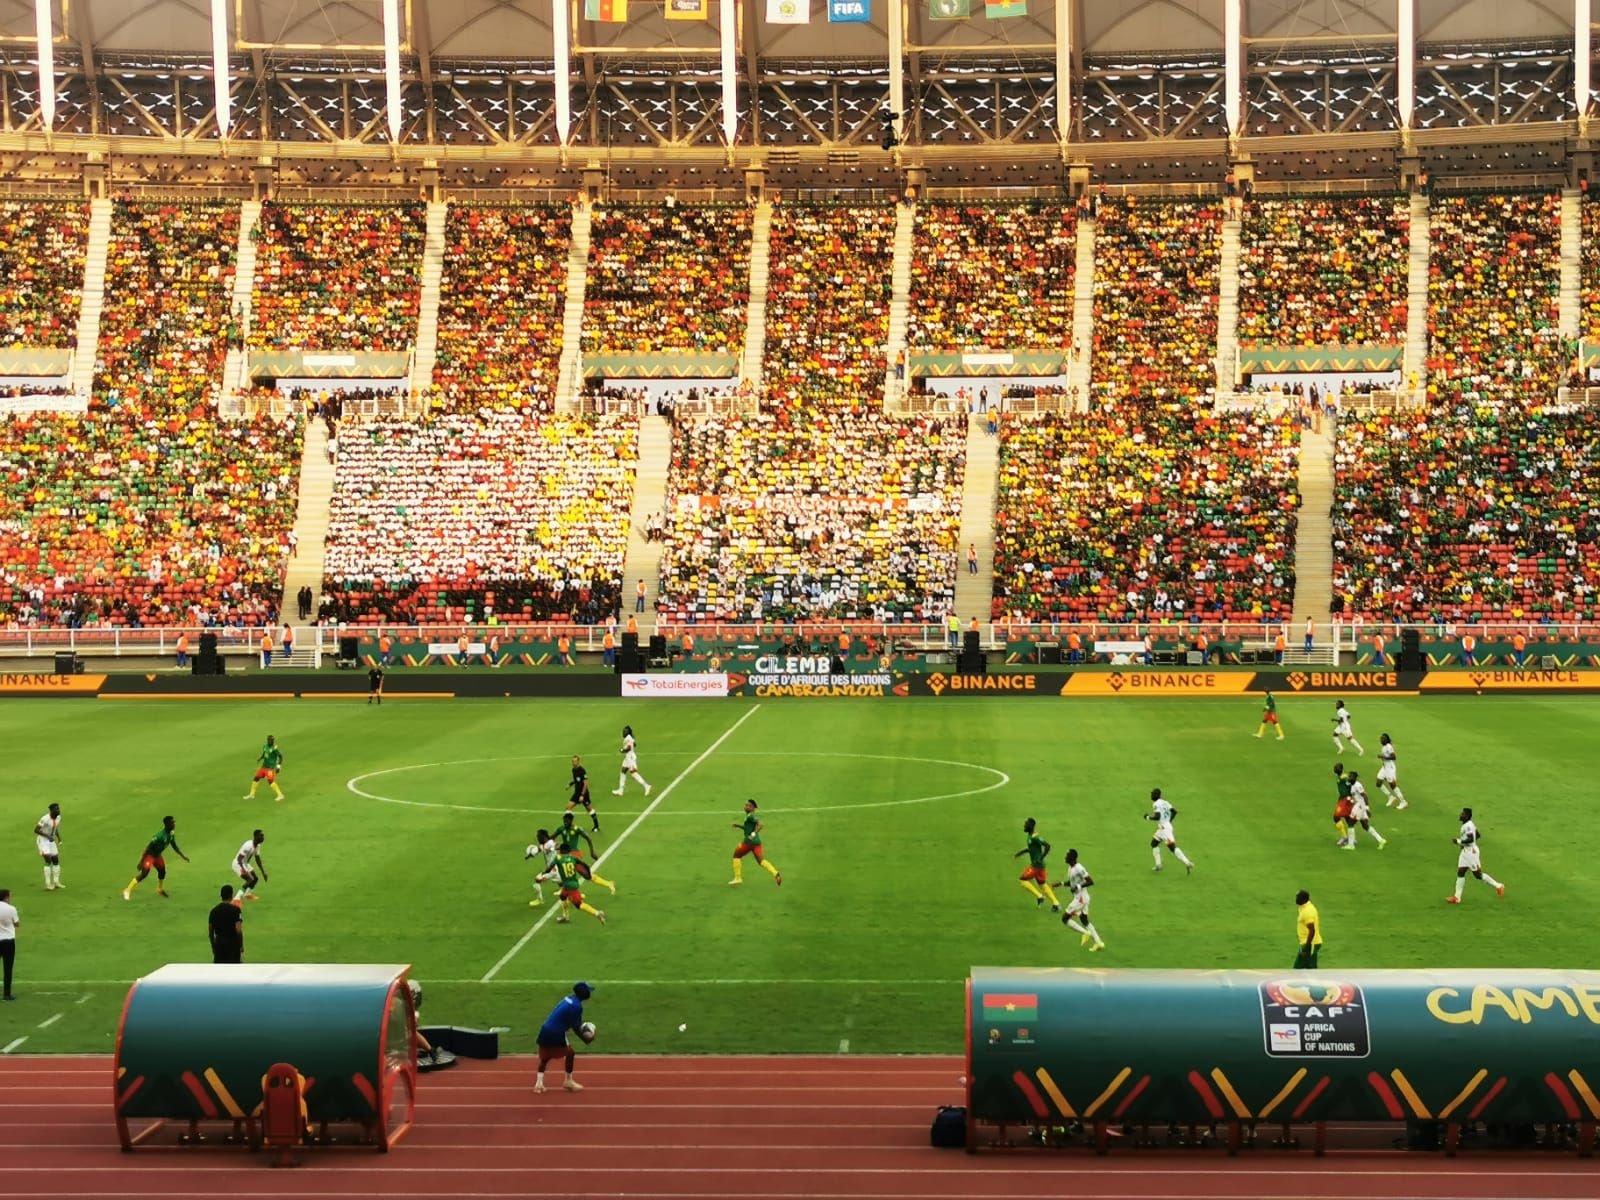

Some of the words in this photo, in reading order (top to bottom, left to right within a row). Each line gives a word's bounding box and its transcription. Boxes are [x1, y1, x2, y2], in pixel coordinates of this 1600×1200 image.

[834, 2, 864, 15] FIFA
[0, 673, 71, 685] INANCE
[748, 674, 779, 686] COUPE
[780, 674, 829, 686] D'AFRIQUE
[831, 674, 849, 686] DES
[851, 674, 891, 686] NATIONS
[950, 675, 1036, 689] BINANCE
[1131, 674, 1215, 687] BINANCE
[1311, 673, 1397, 686] BINANCE
[1494, 672, 1579, 682] BINANCE
[651, 679, 722, 690] TotalEnergies
[1284, 1006, 1343, 1018] CAF
[1303, 1023, 1335, 1032] AFRICA
[1304, 1032, 1322, 1041] CUP
[1305, 1043, 1317, 1051] OF
[1318, 1042, 1355, 1051] NATIONS
